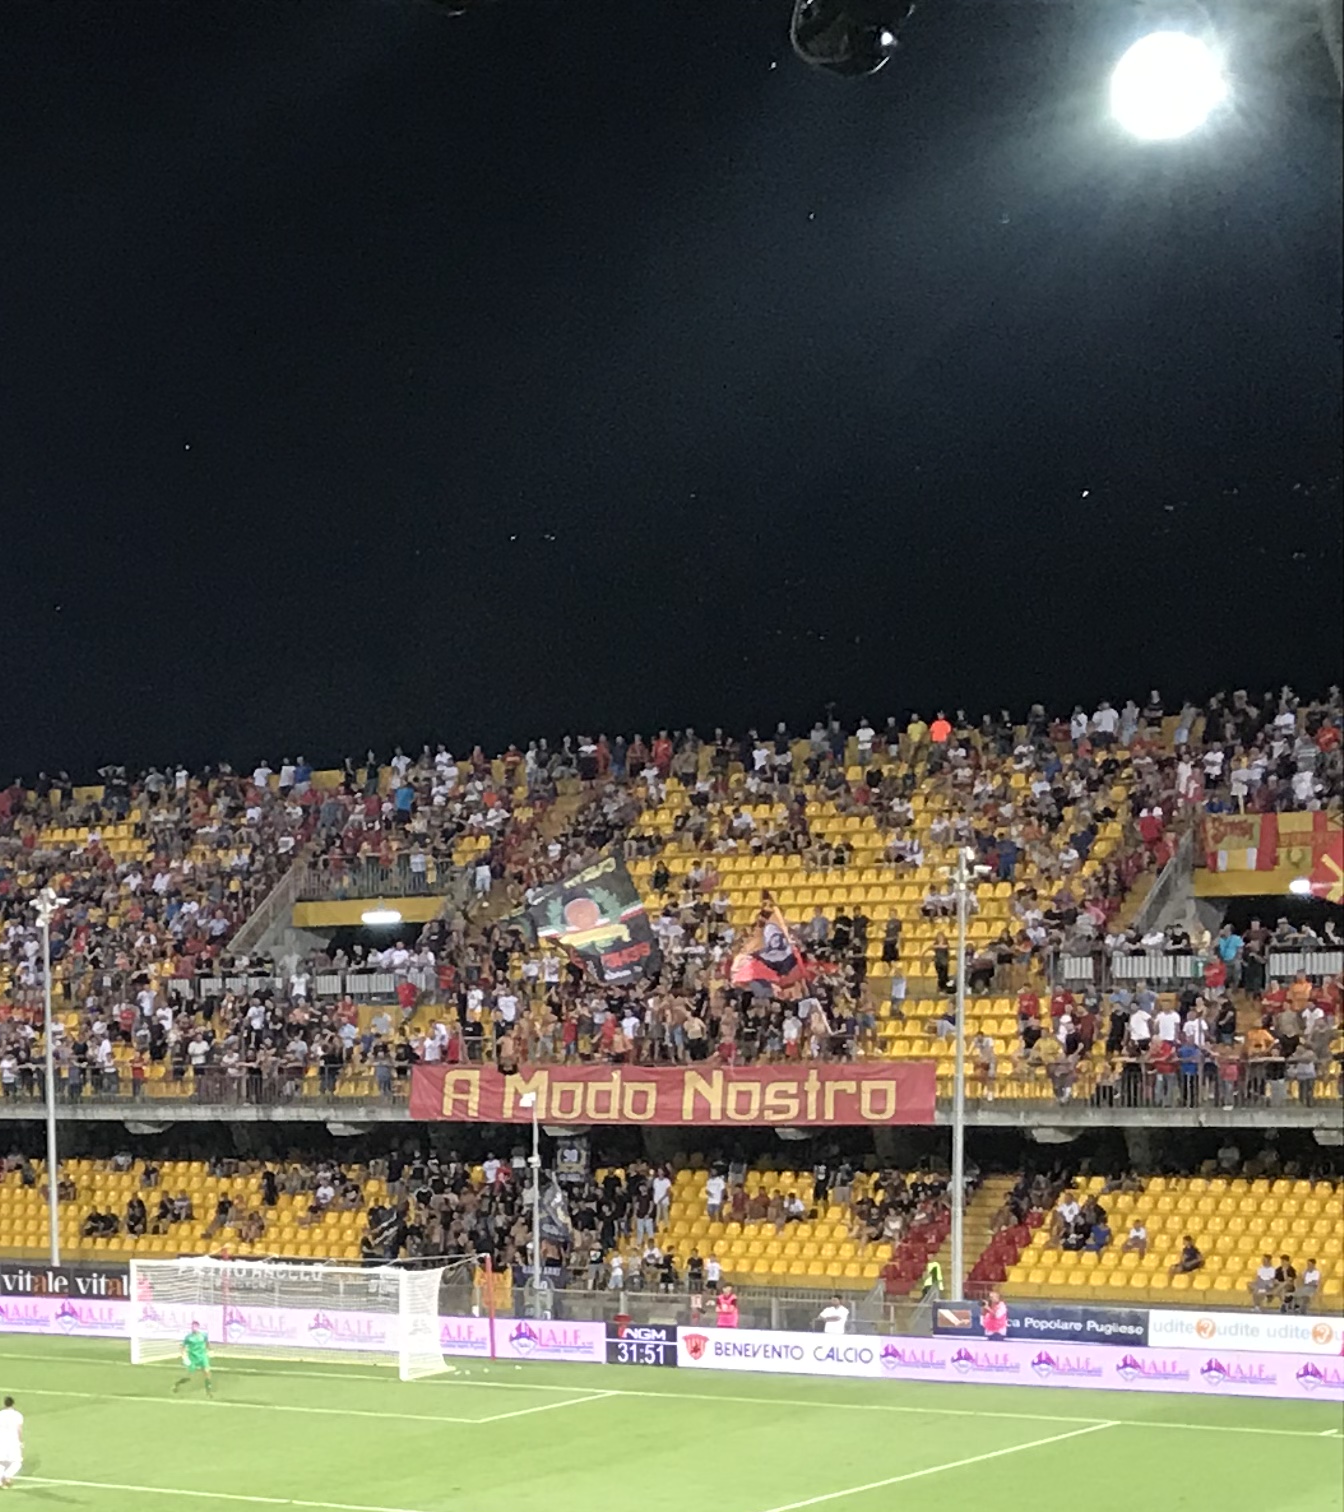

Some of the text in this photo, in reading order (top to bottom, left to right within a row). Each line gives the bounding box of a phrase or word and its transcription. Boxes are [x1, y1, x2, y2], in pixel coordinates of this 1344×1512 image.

[441, 1069, 897, 1121] A Modo Nostro
[1, 1269, 69, 1293] vitale
[75, 1273, 131, 1296] vital
[622, 1327, 667, 1340] NGM
[1024, 1316, 1083, 1331] Popolare
[1086, 1320, 1144, 1335] Pugliese
[617, 1342, 664, 1365] 31:51
[714, 1341, 874, 1364] BENEVENTO CALCIO
